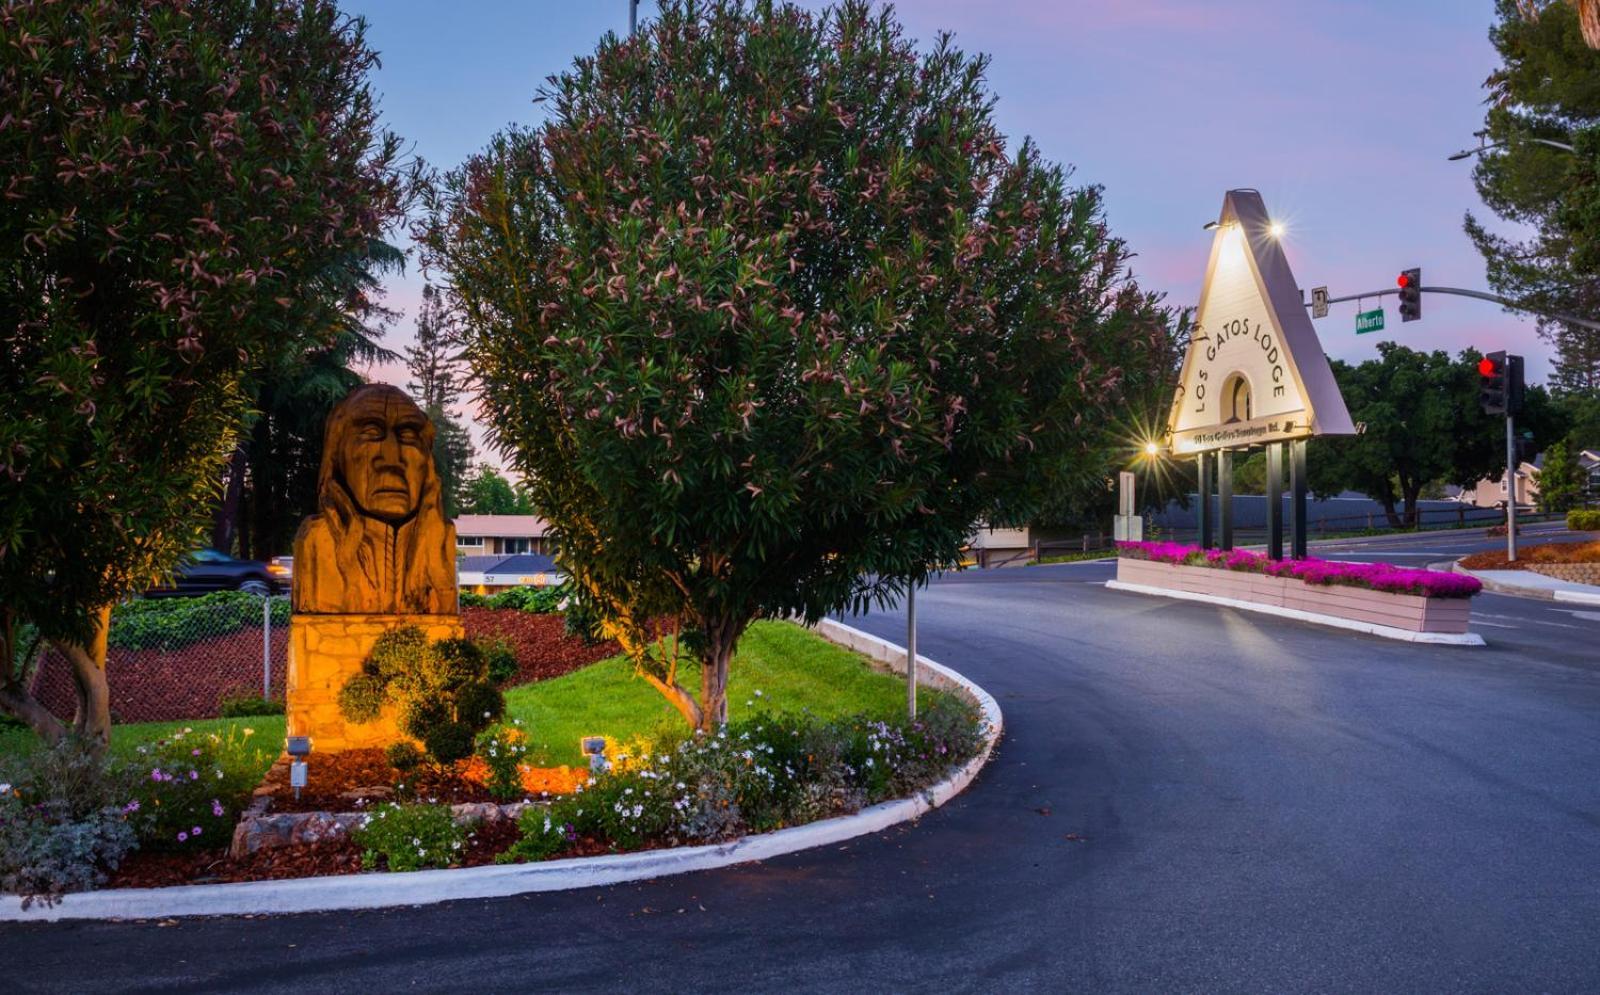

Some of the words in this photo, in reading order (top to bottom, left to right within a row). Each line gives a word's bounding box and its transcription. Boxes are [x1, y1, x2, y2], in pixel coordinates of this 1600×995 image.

[1357, 315, 1383, 330] Alberto
[1195, 370, 1208, 413] LOS
[1206, 318, 1249, 361] GATOS
[1253, 324, 1285, 397] LODGE
